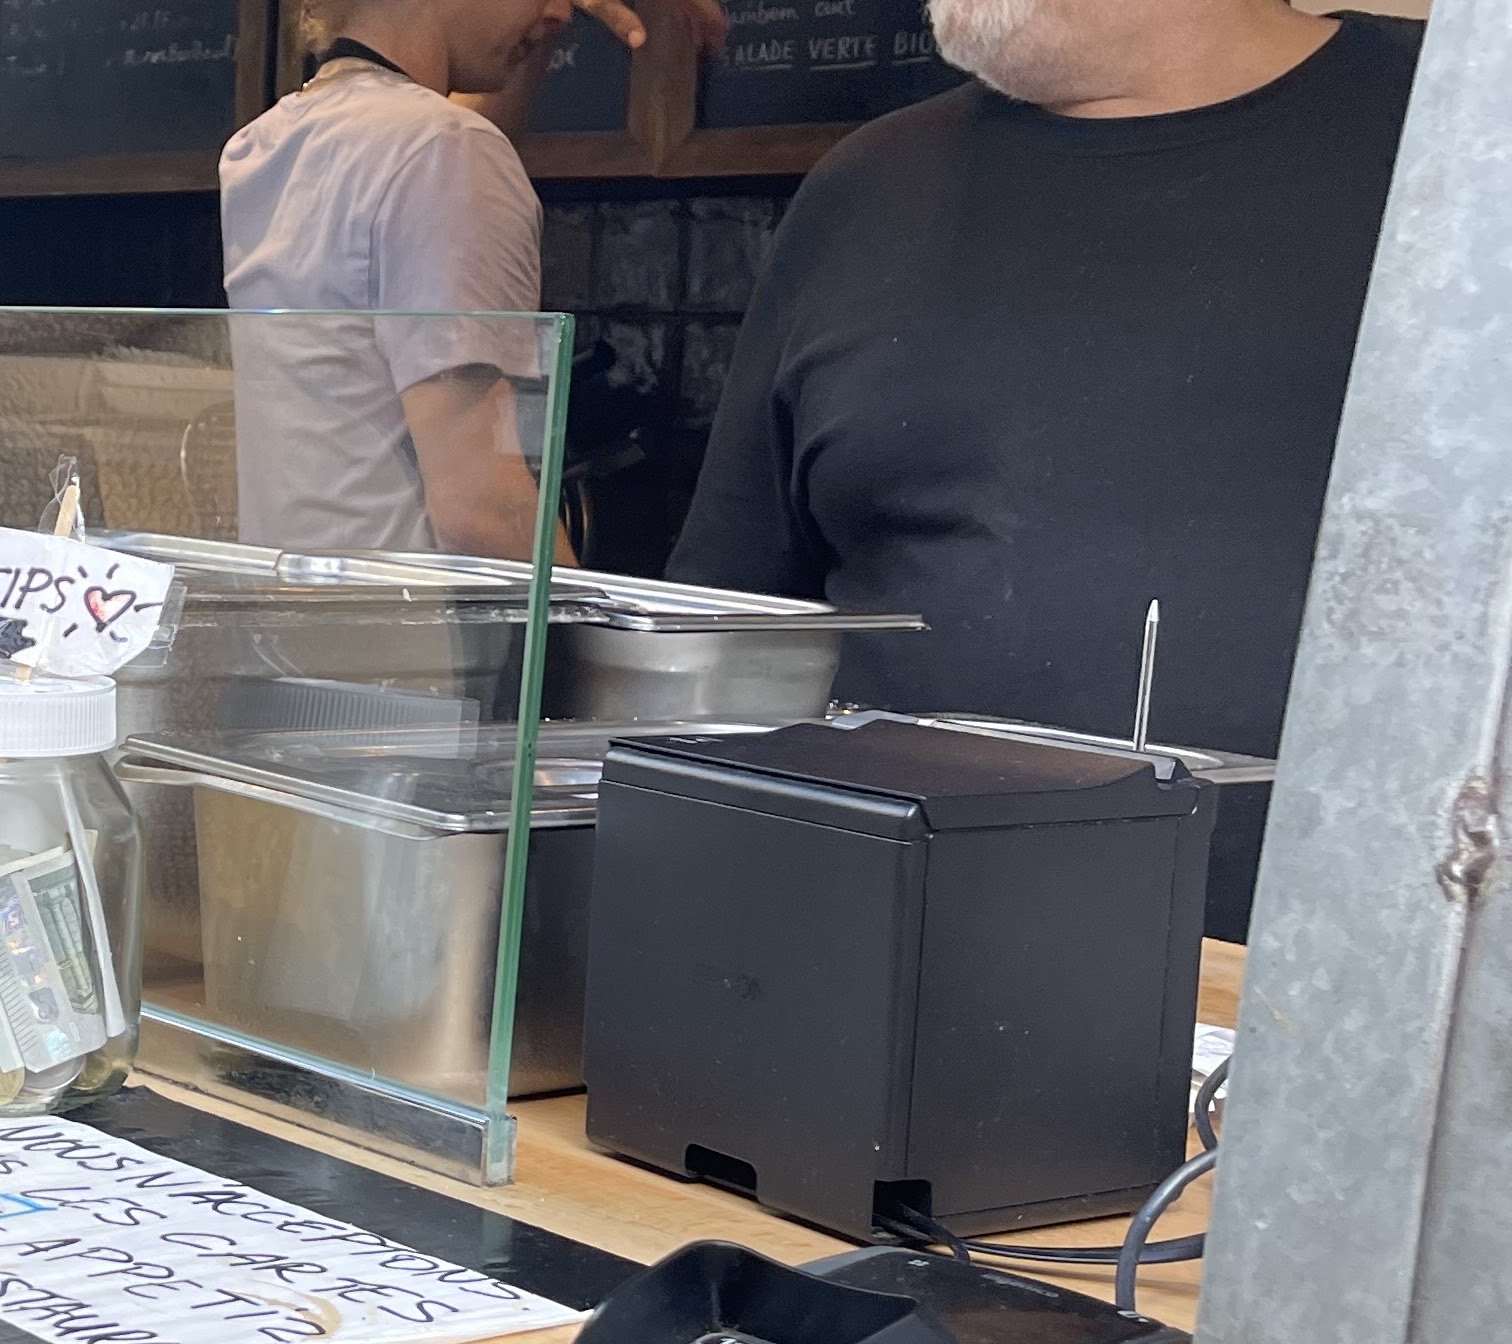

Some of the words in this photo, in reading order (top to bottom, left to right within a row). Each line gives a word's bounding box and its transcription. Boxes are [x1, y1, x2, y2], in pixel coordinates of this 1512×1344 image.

[808, 34, 878, 60] VERTE
[19, 1186, 169, 1227] LES
[159, 1232, 461, 1324] CARTES
